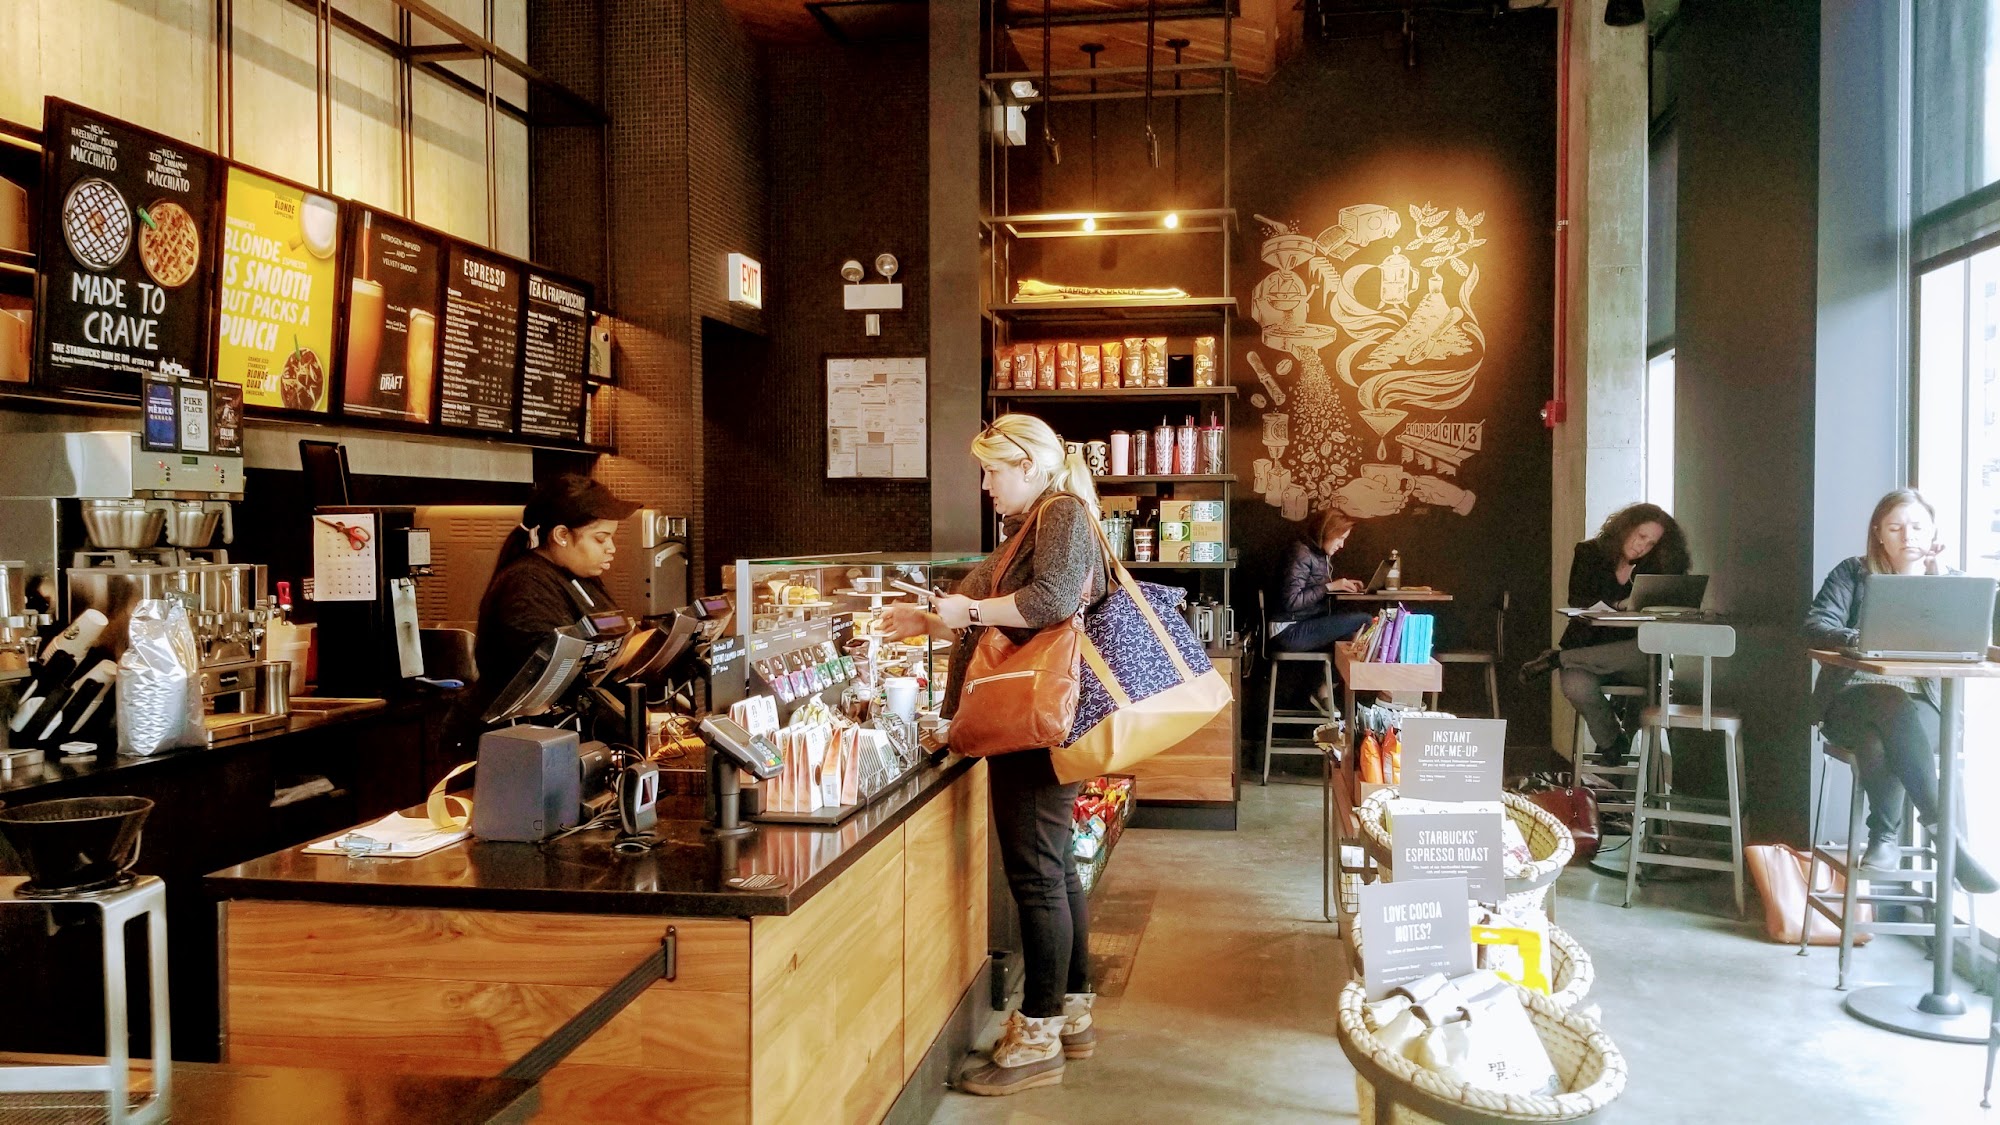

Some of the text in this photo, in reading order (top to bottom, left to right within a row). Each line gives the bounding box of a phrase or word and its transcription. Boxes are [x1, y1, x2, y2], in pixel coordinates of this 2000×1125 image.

[90, 124, 104, 135] NEW
[70, 145, 118, 172] MACCHIATO
[162, 148, 177, 160] NEW
[146, 170, 191, 193] MACCHIATO
[274, 200, 295, 214] BLONDE
[224, 226, 283, 263] BLONDE
[242, 260, 313, 302] SMOOTH
[463, 258, 506, 288] ESPRESSO
[742, 263, 758, 300] EXIT
[71, 271, 166, 315] MADE TO
[528, 280, 541, 297] TEA
[542, 283, 548, 300] &
[221, 287, 311, 328] BUT PACKS A
[84, 311, 159, 350] CRAVE
[220, 313, 280, 353] PUNCH
[52, 342, 65, 353] THE
[246, 380, 262, 389] QUAD
[247, 369, 268, 380] BLONDE
[379, 375, 404, 391] DRAFT
[183, 396, 203, 407] PIKE
[183, 405, 203, 414] PLACE
[1432, 731, 1472, 743] INSTANT
[1424, 744, 1478, 757] PICK-ME-UP
[1405, 847, 1489, 862] ESPRESSO ROAST
[1383, 901, 1442, 923] LOVE COCOA
[1395, 922, 1432, 943] NOTES?
